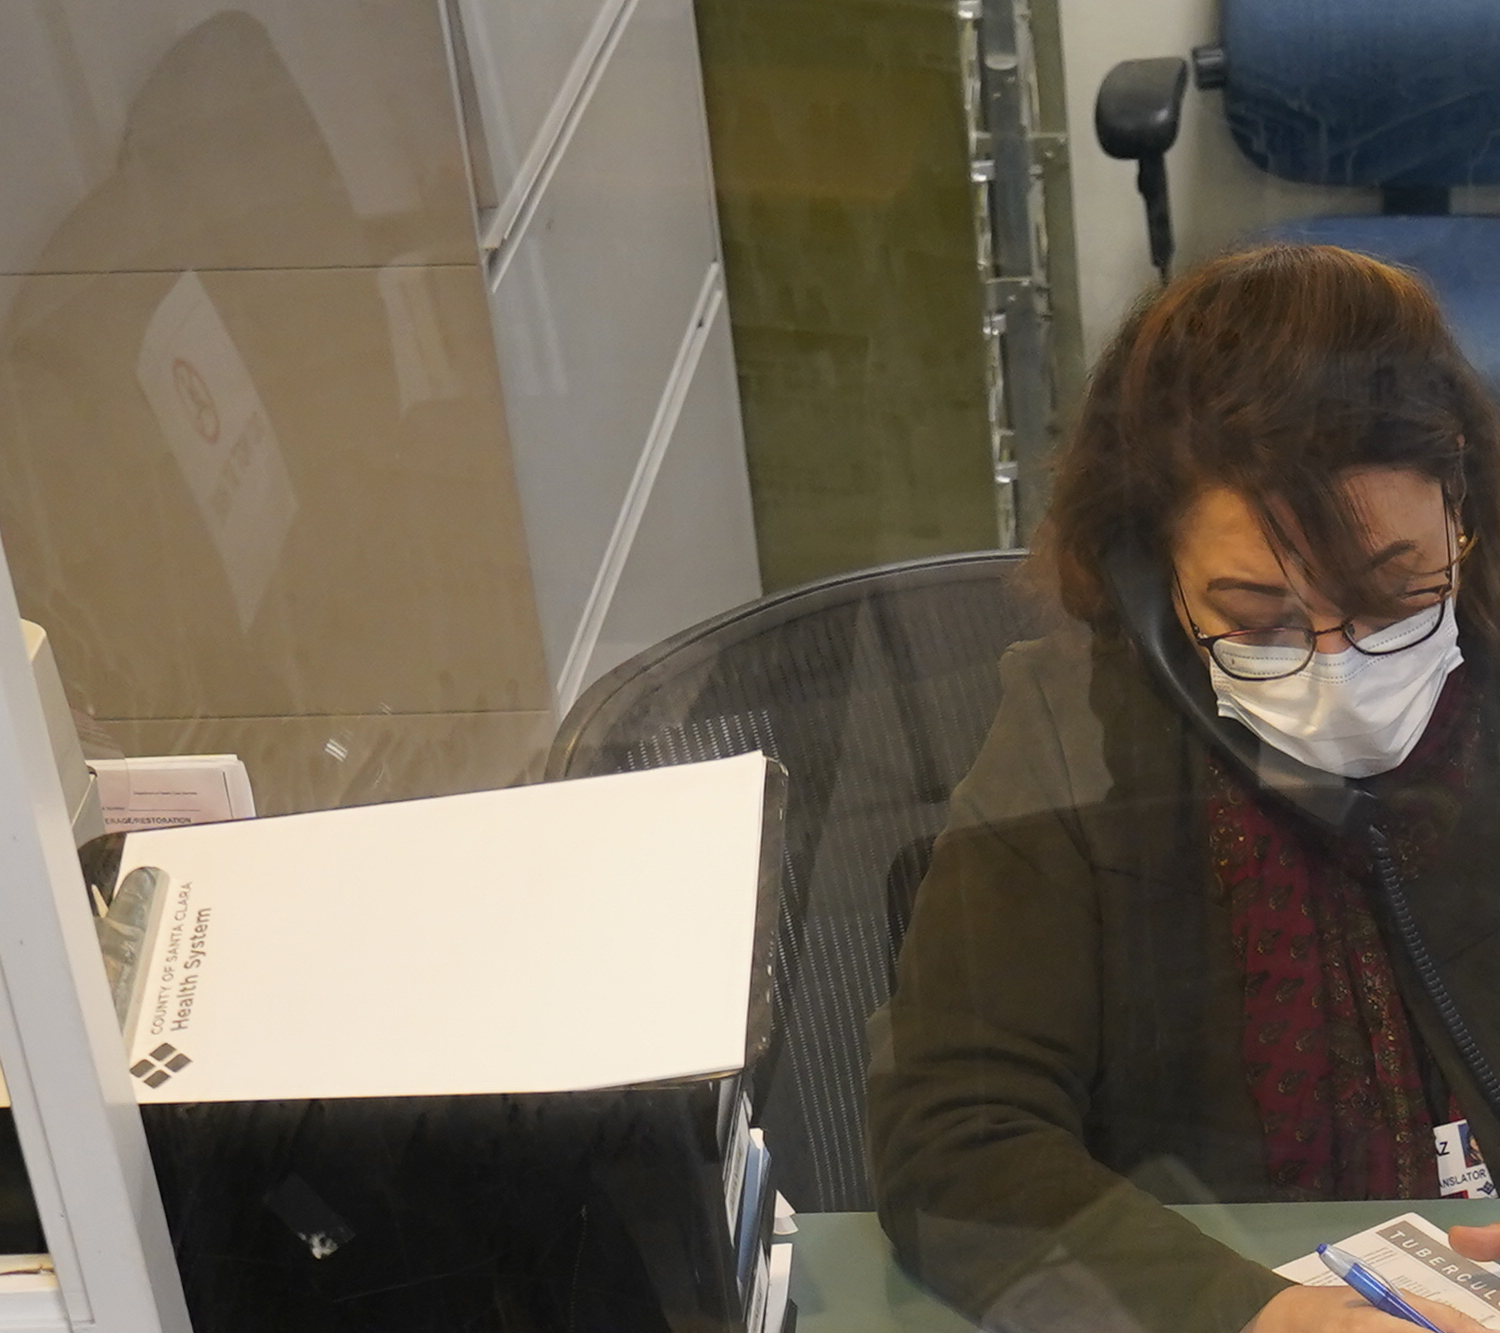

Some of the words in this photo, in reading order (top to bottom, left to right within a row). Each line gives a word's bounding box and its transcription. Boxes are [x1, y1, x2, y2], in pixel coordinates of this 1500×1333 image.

[175, 882, 193, 921] CLARA
[167, 923, 183, 962] SANTA
[161, 966, 174, 982] OF
[170, 974, 198, 1032] Health
[184, 907, 212, 973] System
[151, 986, 171, 1035] COUNTY
